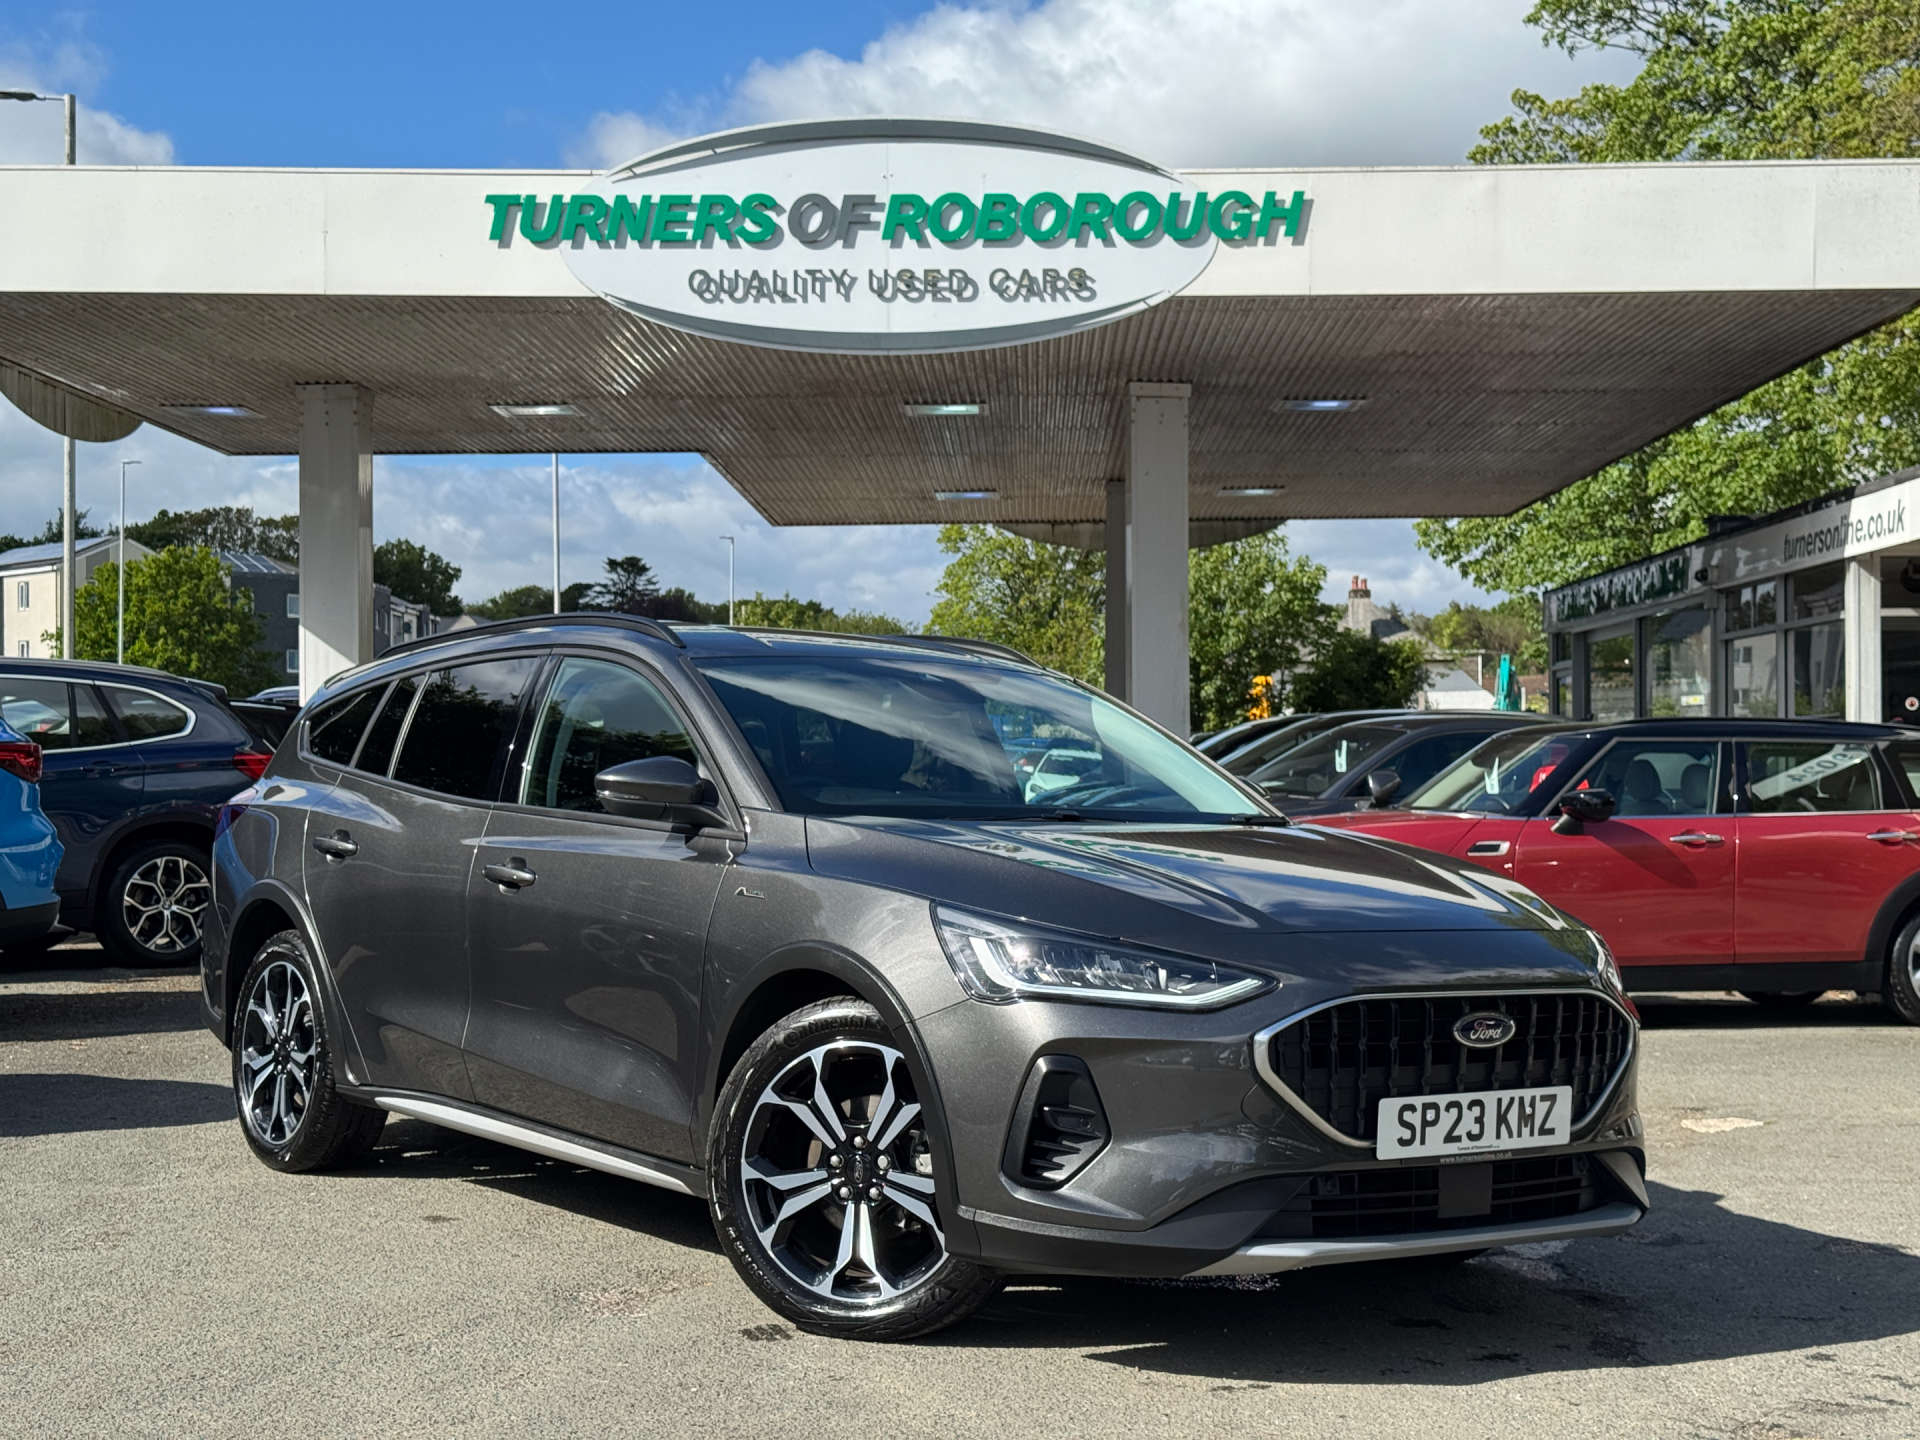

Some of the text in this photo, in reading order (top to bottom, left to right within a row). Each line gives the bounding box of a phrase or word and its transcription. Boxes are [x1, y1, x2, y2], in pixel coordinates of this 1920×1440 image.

[484, 190, 1307, 245] TURNERS OF ROBOROUGH
[688, 267, 1092, 300] QUALITY USED CARS
[1783, 499, 1906, 562] turnersonline.co.uk
[1470, 1019, 1504, 1040] Ford
[1396, 1094, 1558, 1148] SP23 KMZ
